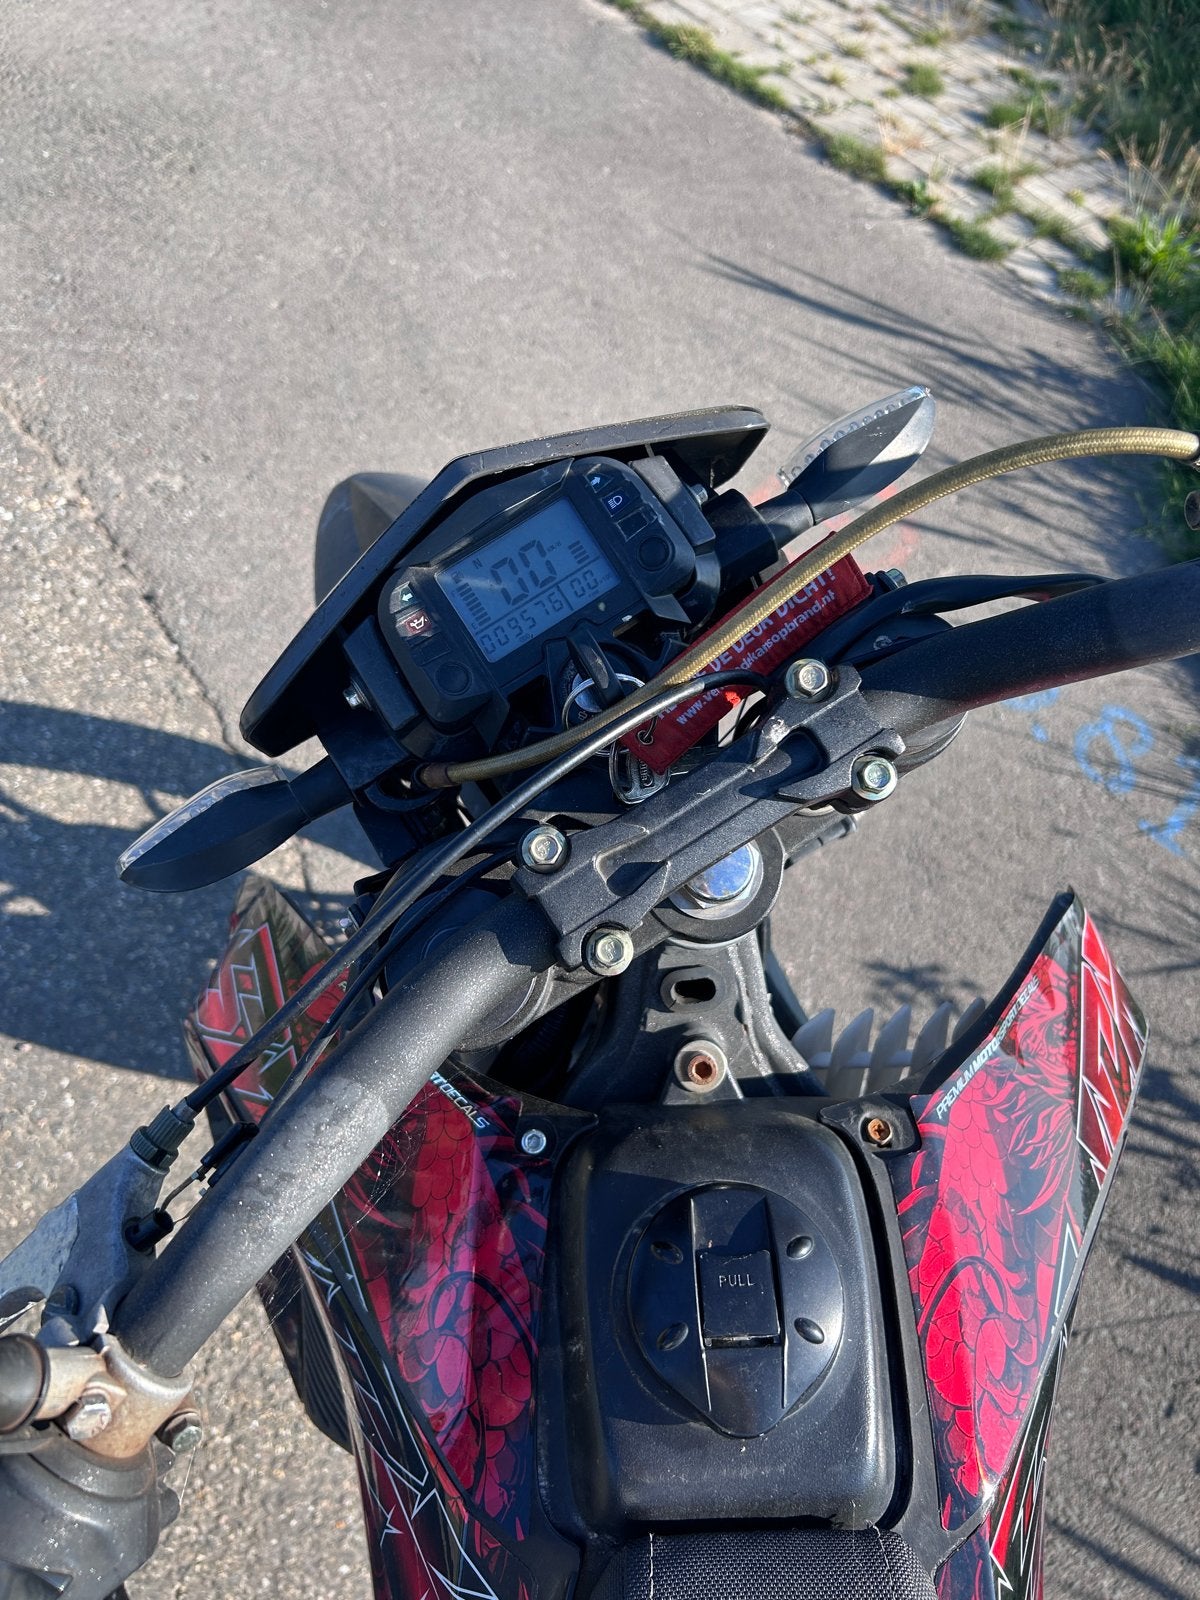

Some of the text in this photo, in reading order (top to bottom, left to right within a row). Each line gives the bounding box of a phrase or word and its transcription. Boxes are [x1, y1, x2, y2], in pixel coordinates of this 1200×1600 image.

[472, 558, 482, 569] N
[489, 538, 558, 606] 00
[569, 569, 599, 598] 00
[479, 592, 564, 655] 009576
[718, 1273, 755, 1287] PULL
